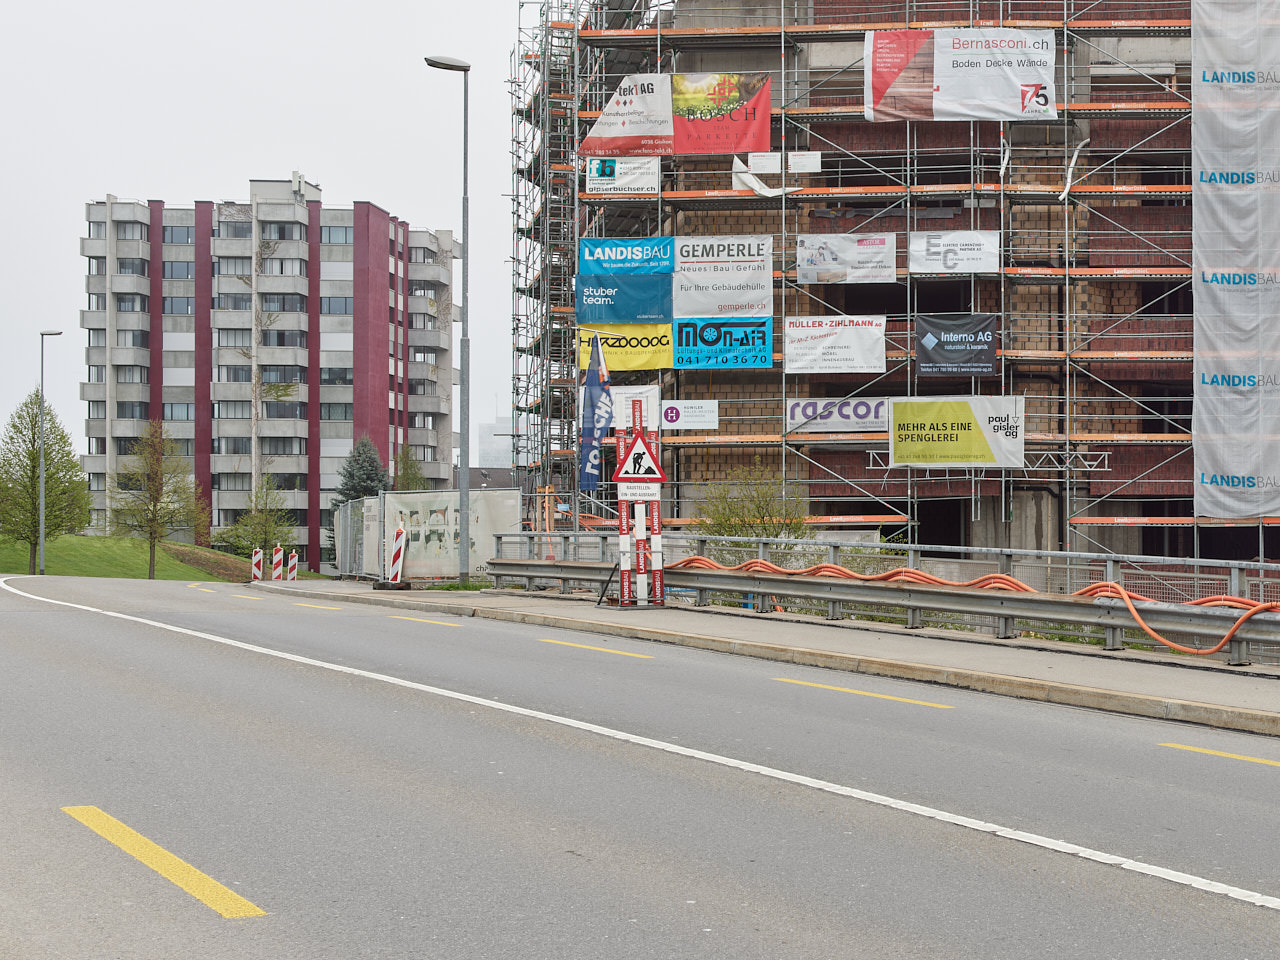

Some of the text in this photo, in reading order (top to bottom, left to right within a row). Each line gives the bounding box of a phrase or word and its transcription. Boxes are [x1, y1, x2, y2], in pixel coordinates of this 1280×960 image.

[952, 37, 1049, 50] Bernasconi.ch
[952, 58, 1048, 69] Boden Decke Wände
[640, 82, 655, 94] AG
[687, 104, 756, 123] BÖSCH
[1199, 171, 1280, 184] LANDISBAU
[584, 245, 670, 260] LANDISBAU
[680, 243, 764, 257] GEMPERLE
[583, 287, 618, 296] stuber
[711, 283, 766, 291] Gebäudehülle
[583, 296, 614, 305] team.
[717, 302, 766, 311] gemperle.ch
[788, 320, 824, 329] MÜLLER
[941, 331, 992, 342] Interno AG
[677, 356, 699, 364] 041
[705, 356, 728, 364] 710
[790, 401, 885, 421] rascor
[988, 414, 1009, 424] paul
[898, 422, 972, 431] MEHR ALS EINE
[993, 423, 1019, 433] gisler
[898, 434, 959, 442] SPENGLEREI
[1005, 430, 1018, 439] ag
